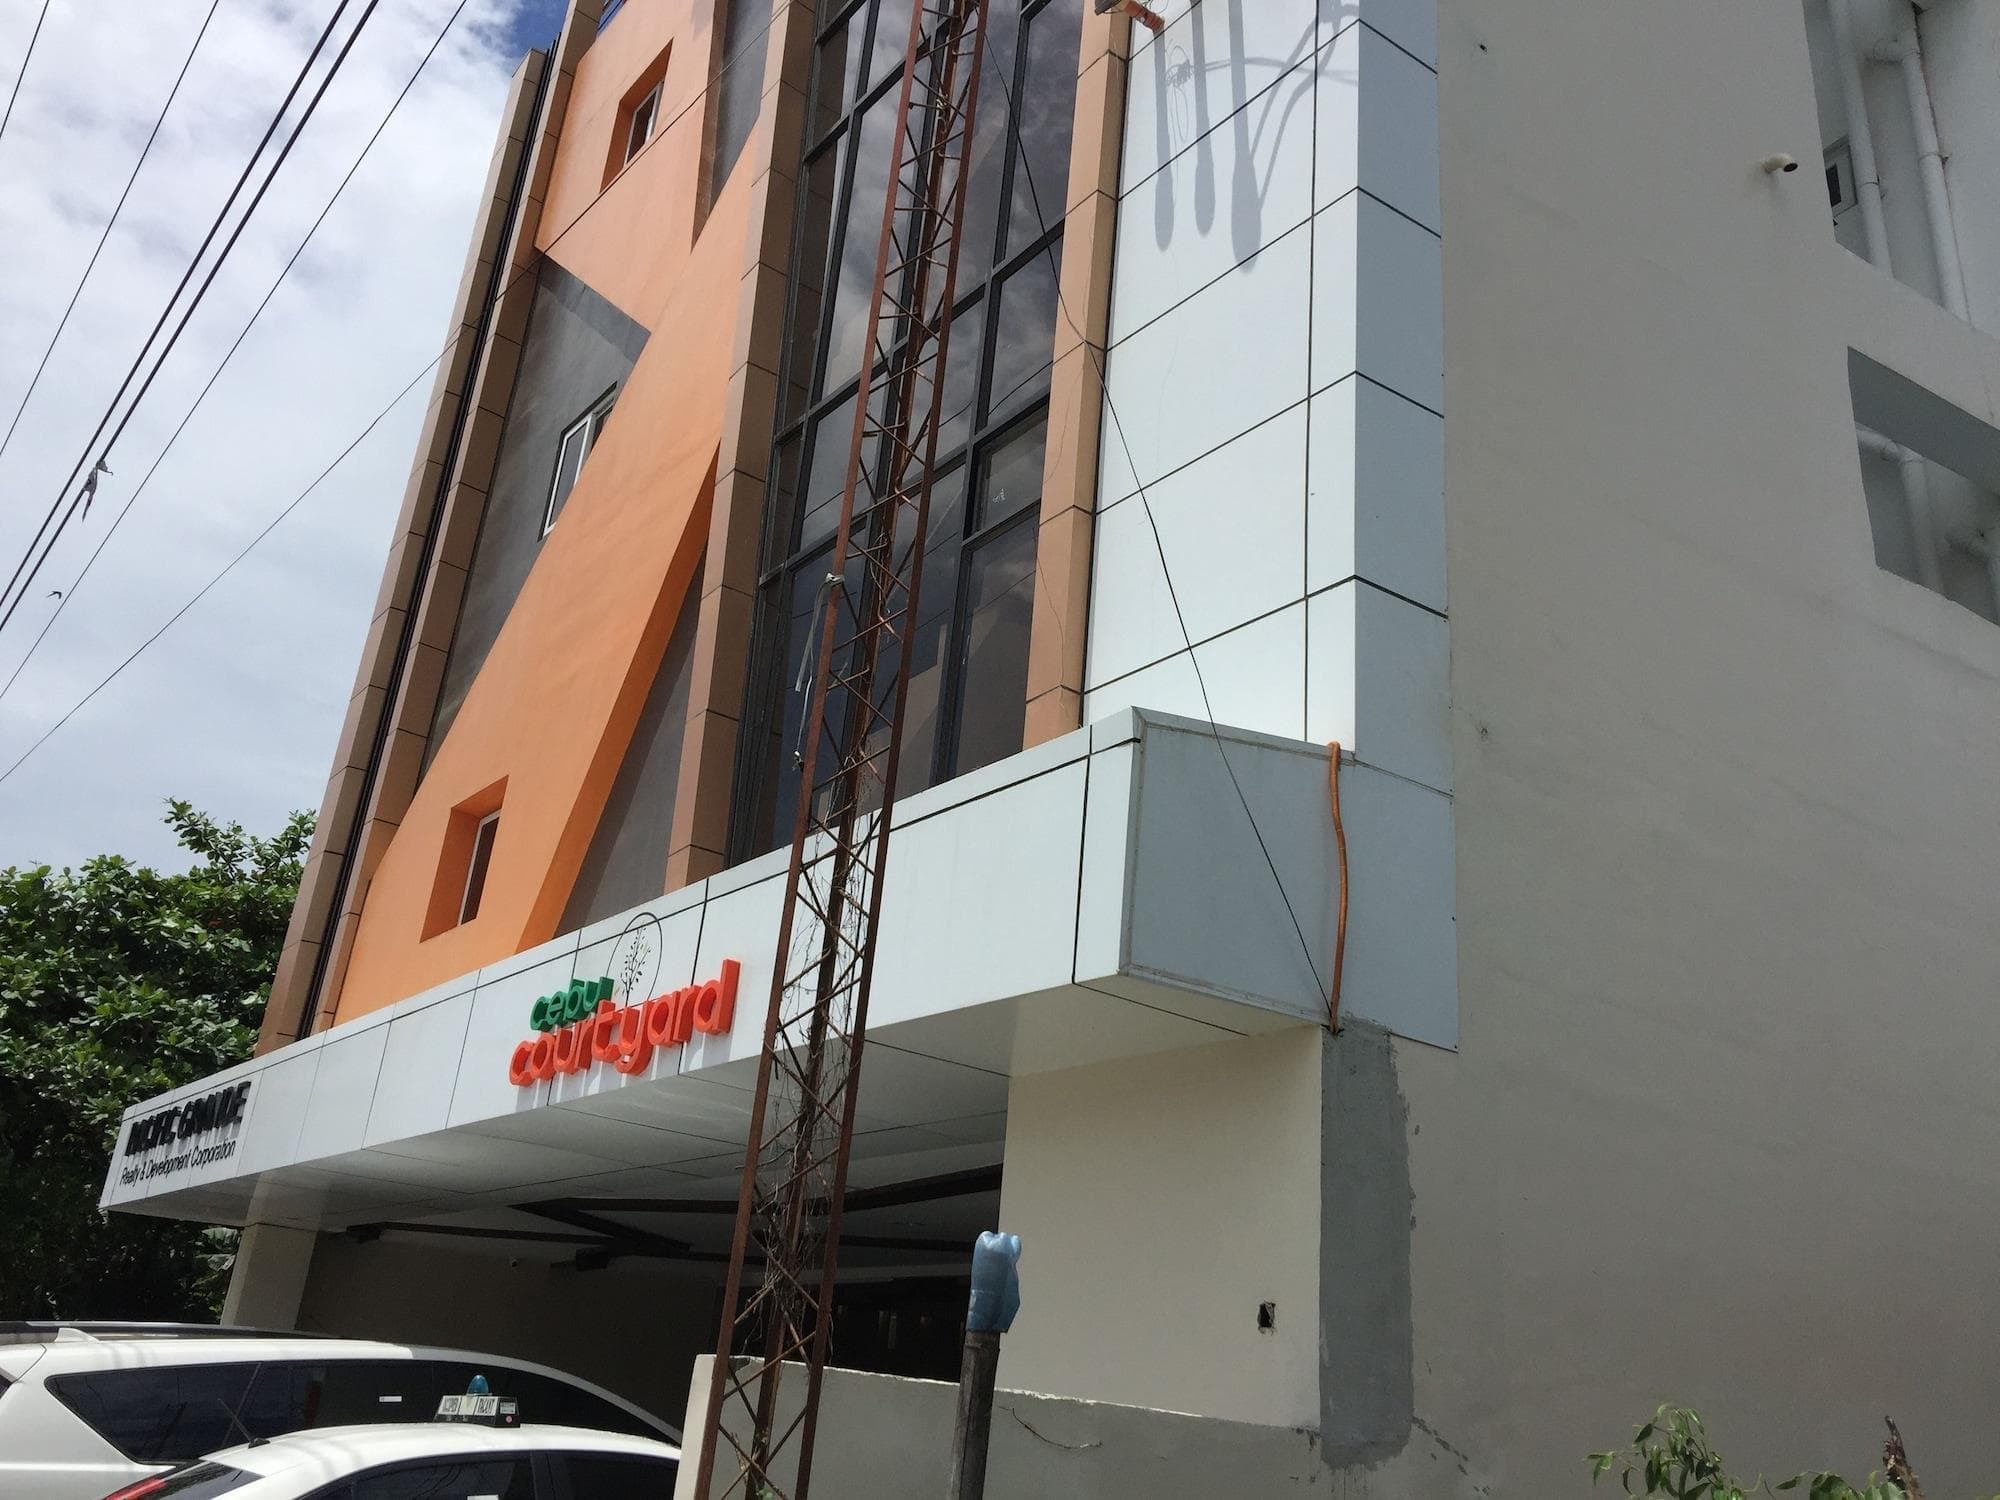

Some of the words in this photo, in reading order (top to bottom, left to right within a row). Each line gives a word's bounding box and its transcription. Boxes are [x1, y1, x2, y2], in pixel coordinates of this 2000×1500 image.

[509, 958, 741, 1088] courtyard
[530, 976, 615, 1033] cebu
[190, 1138, 236, 1170] Corporation
